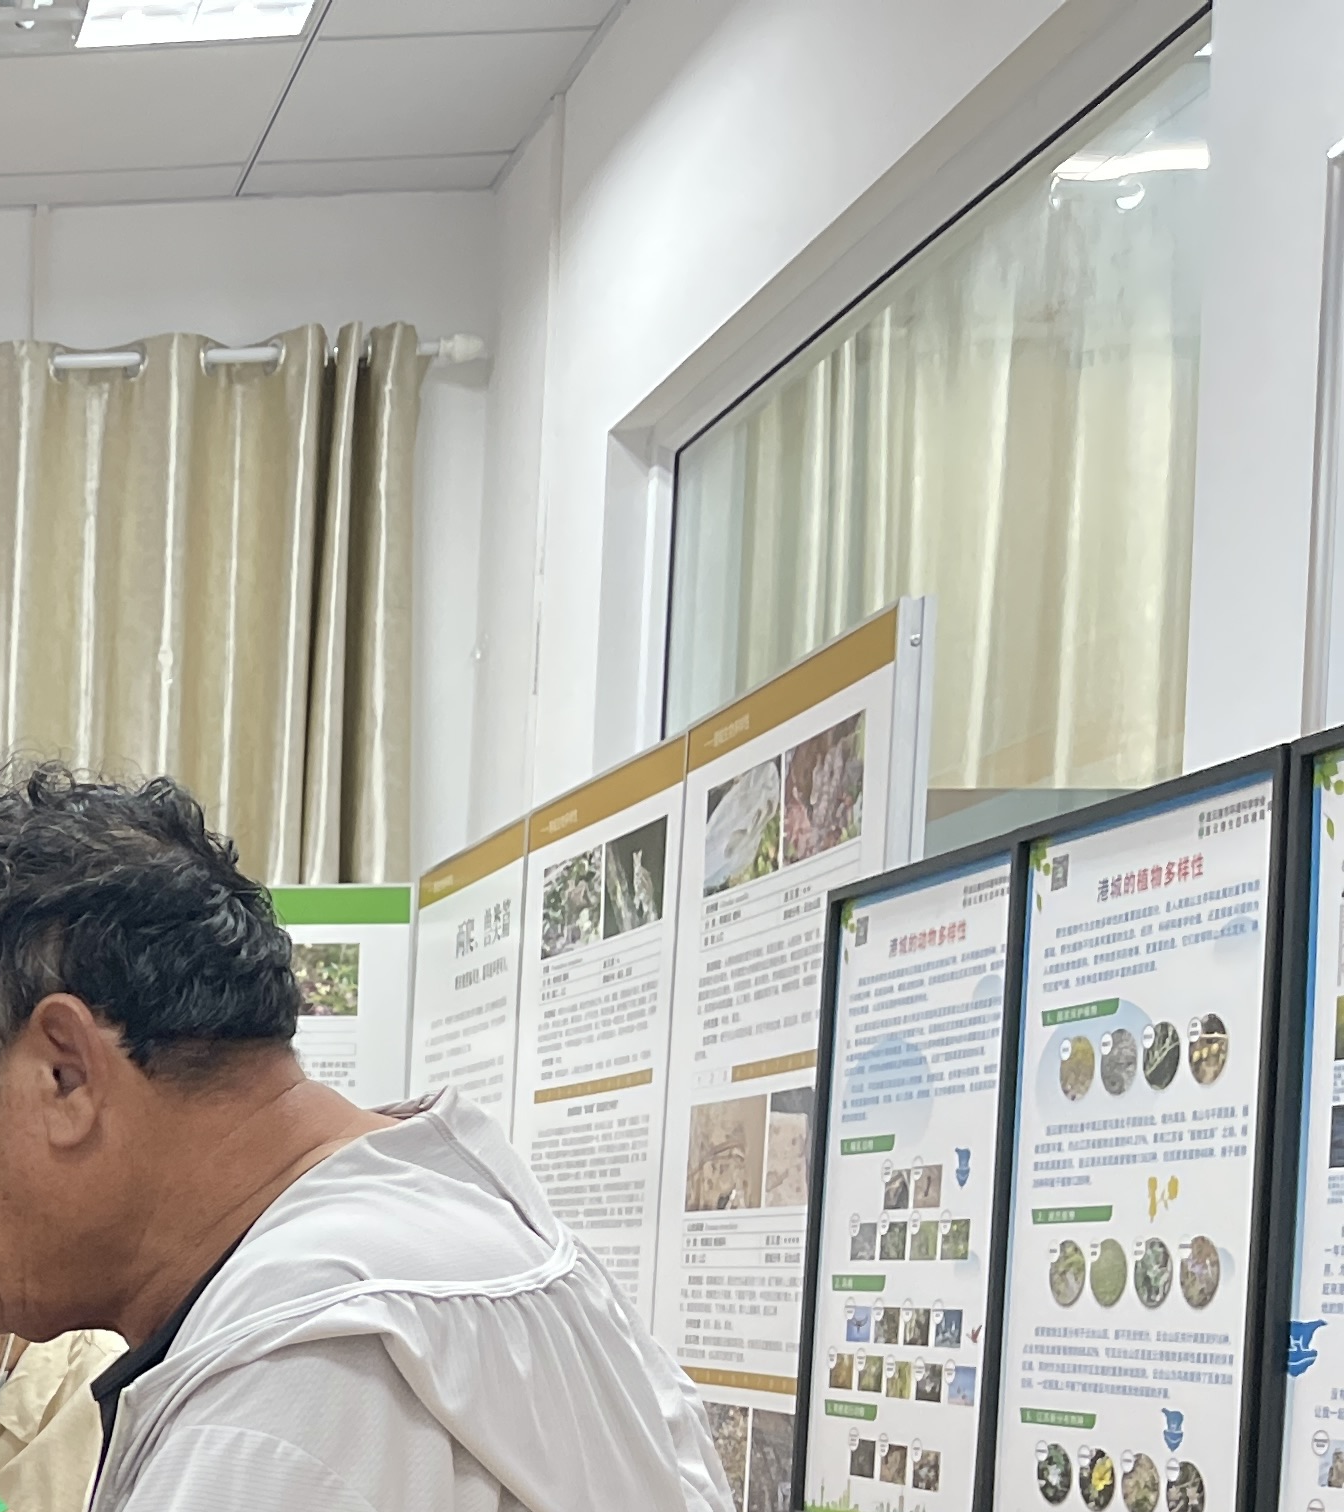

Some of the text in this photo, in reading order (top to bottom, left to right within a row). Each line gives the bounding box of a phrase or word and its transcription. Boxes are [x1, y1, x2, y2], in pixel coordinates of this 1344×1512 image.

[1097, 852, 1204, 903] 港城的植物多样性
